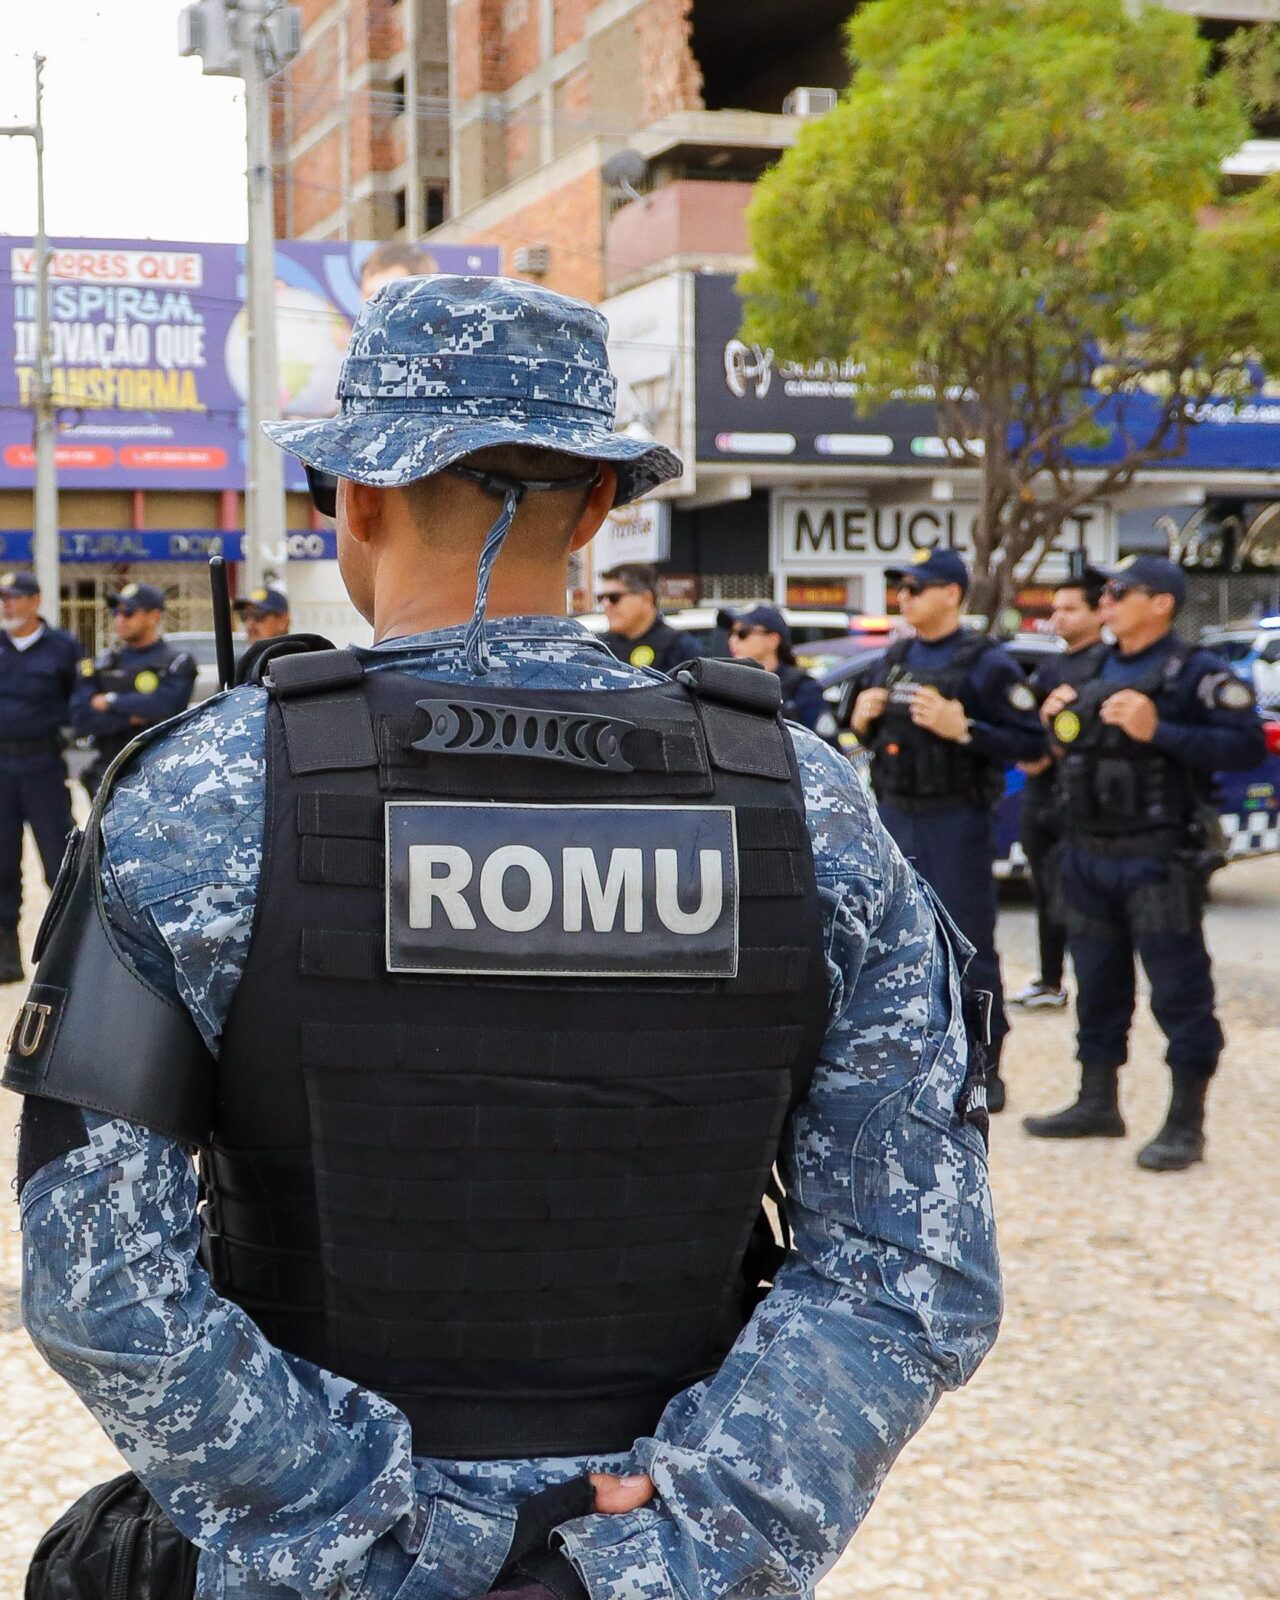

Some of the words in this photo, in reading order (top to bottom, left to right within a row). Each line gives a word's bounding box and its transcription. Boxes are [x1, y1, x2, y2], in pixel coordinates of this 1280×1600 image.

[18, 253, 129, 280] VLORES
[138, 254, 196, 281] QUE
[154, 324, 207, 369] QUE
[29, 534, 150, 559] LTURAL
[407, 844, 724, 935] ROMU
